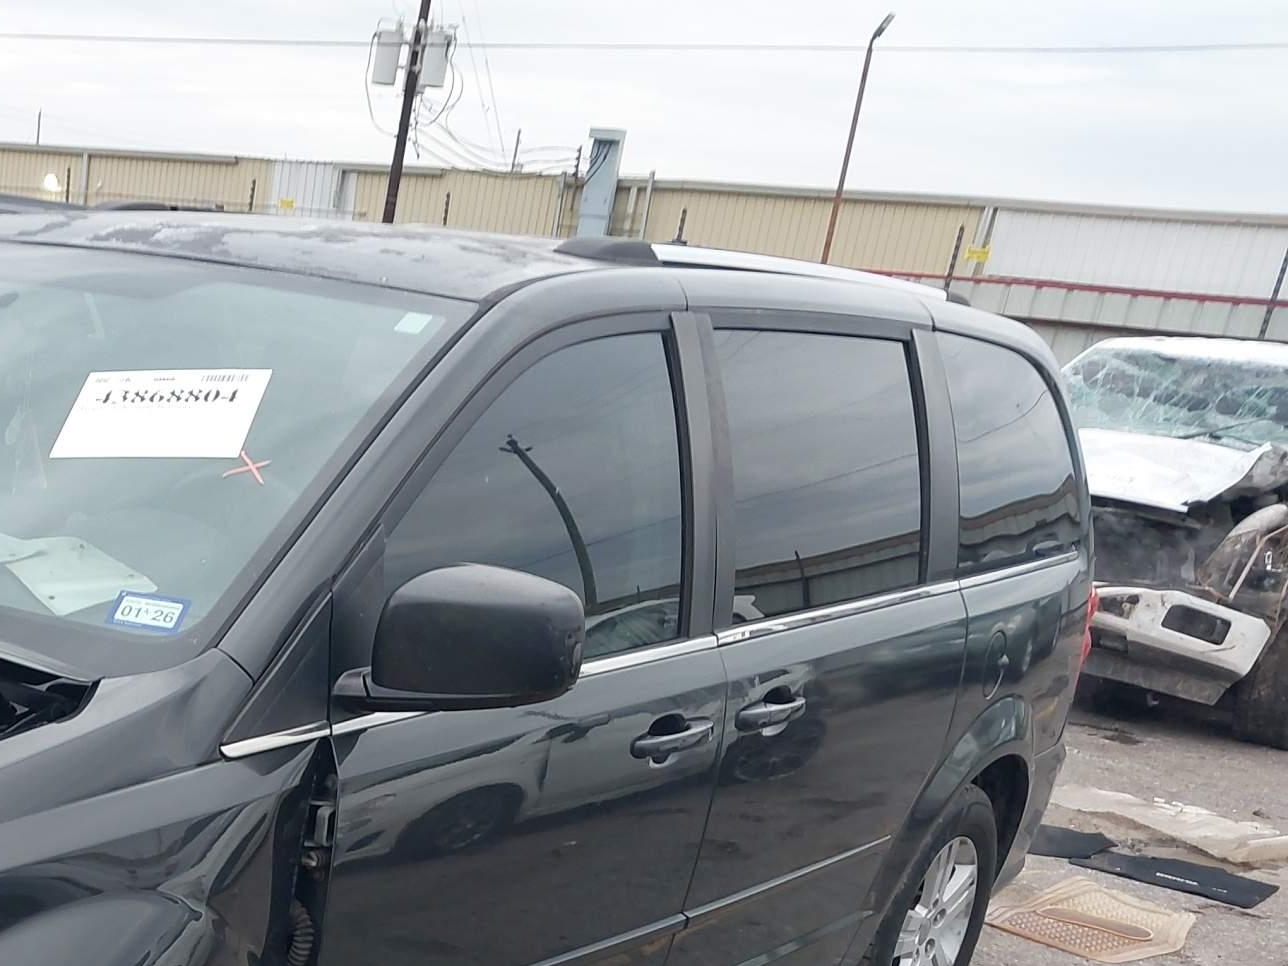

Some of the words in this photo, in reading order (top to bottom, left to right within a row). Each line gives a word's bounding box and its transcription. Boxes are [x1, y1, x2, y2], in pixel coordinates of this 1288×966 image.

[96, 389, 238, 403] 43868804
[120, 605, 141, 618] 01
[152, 610, 175, 623] 26
